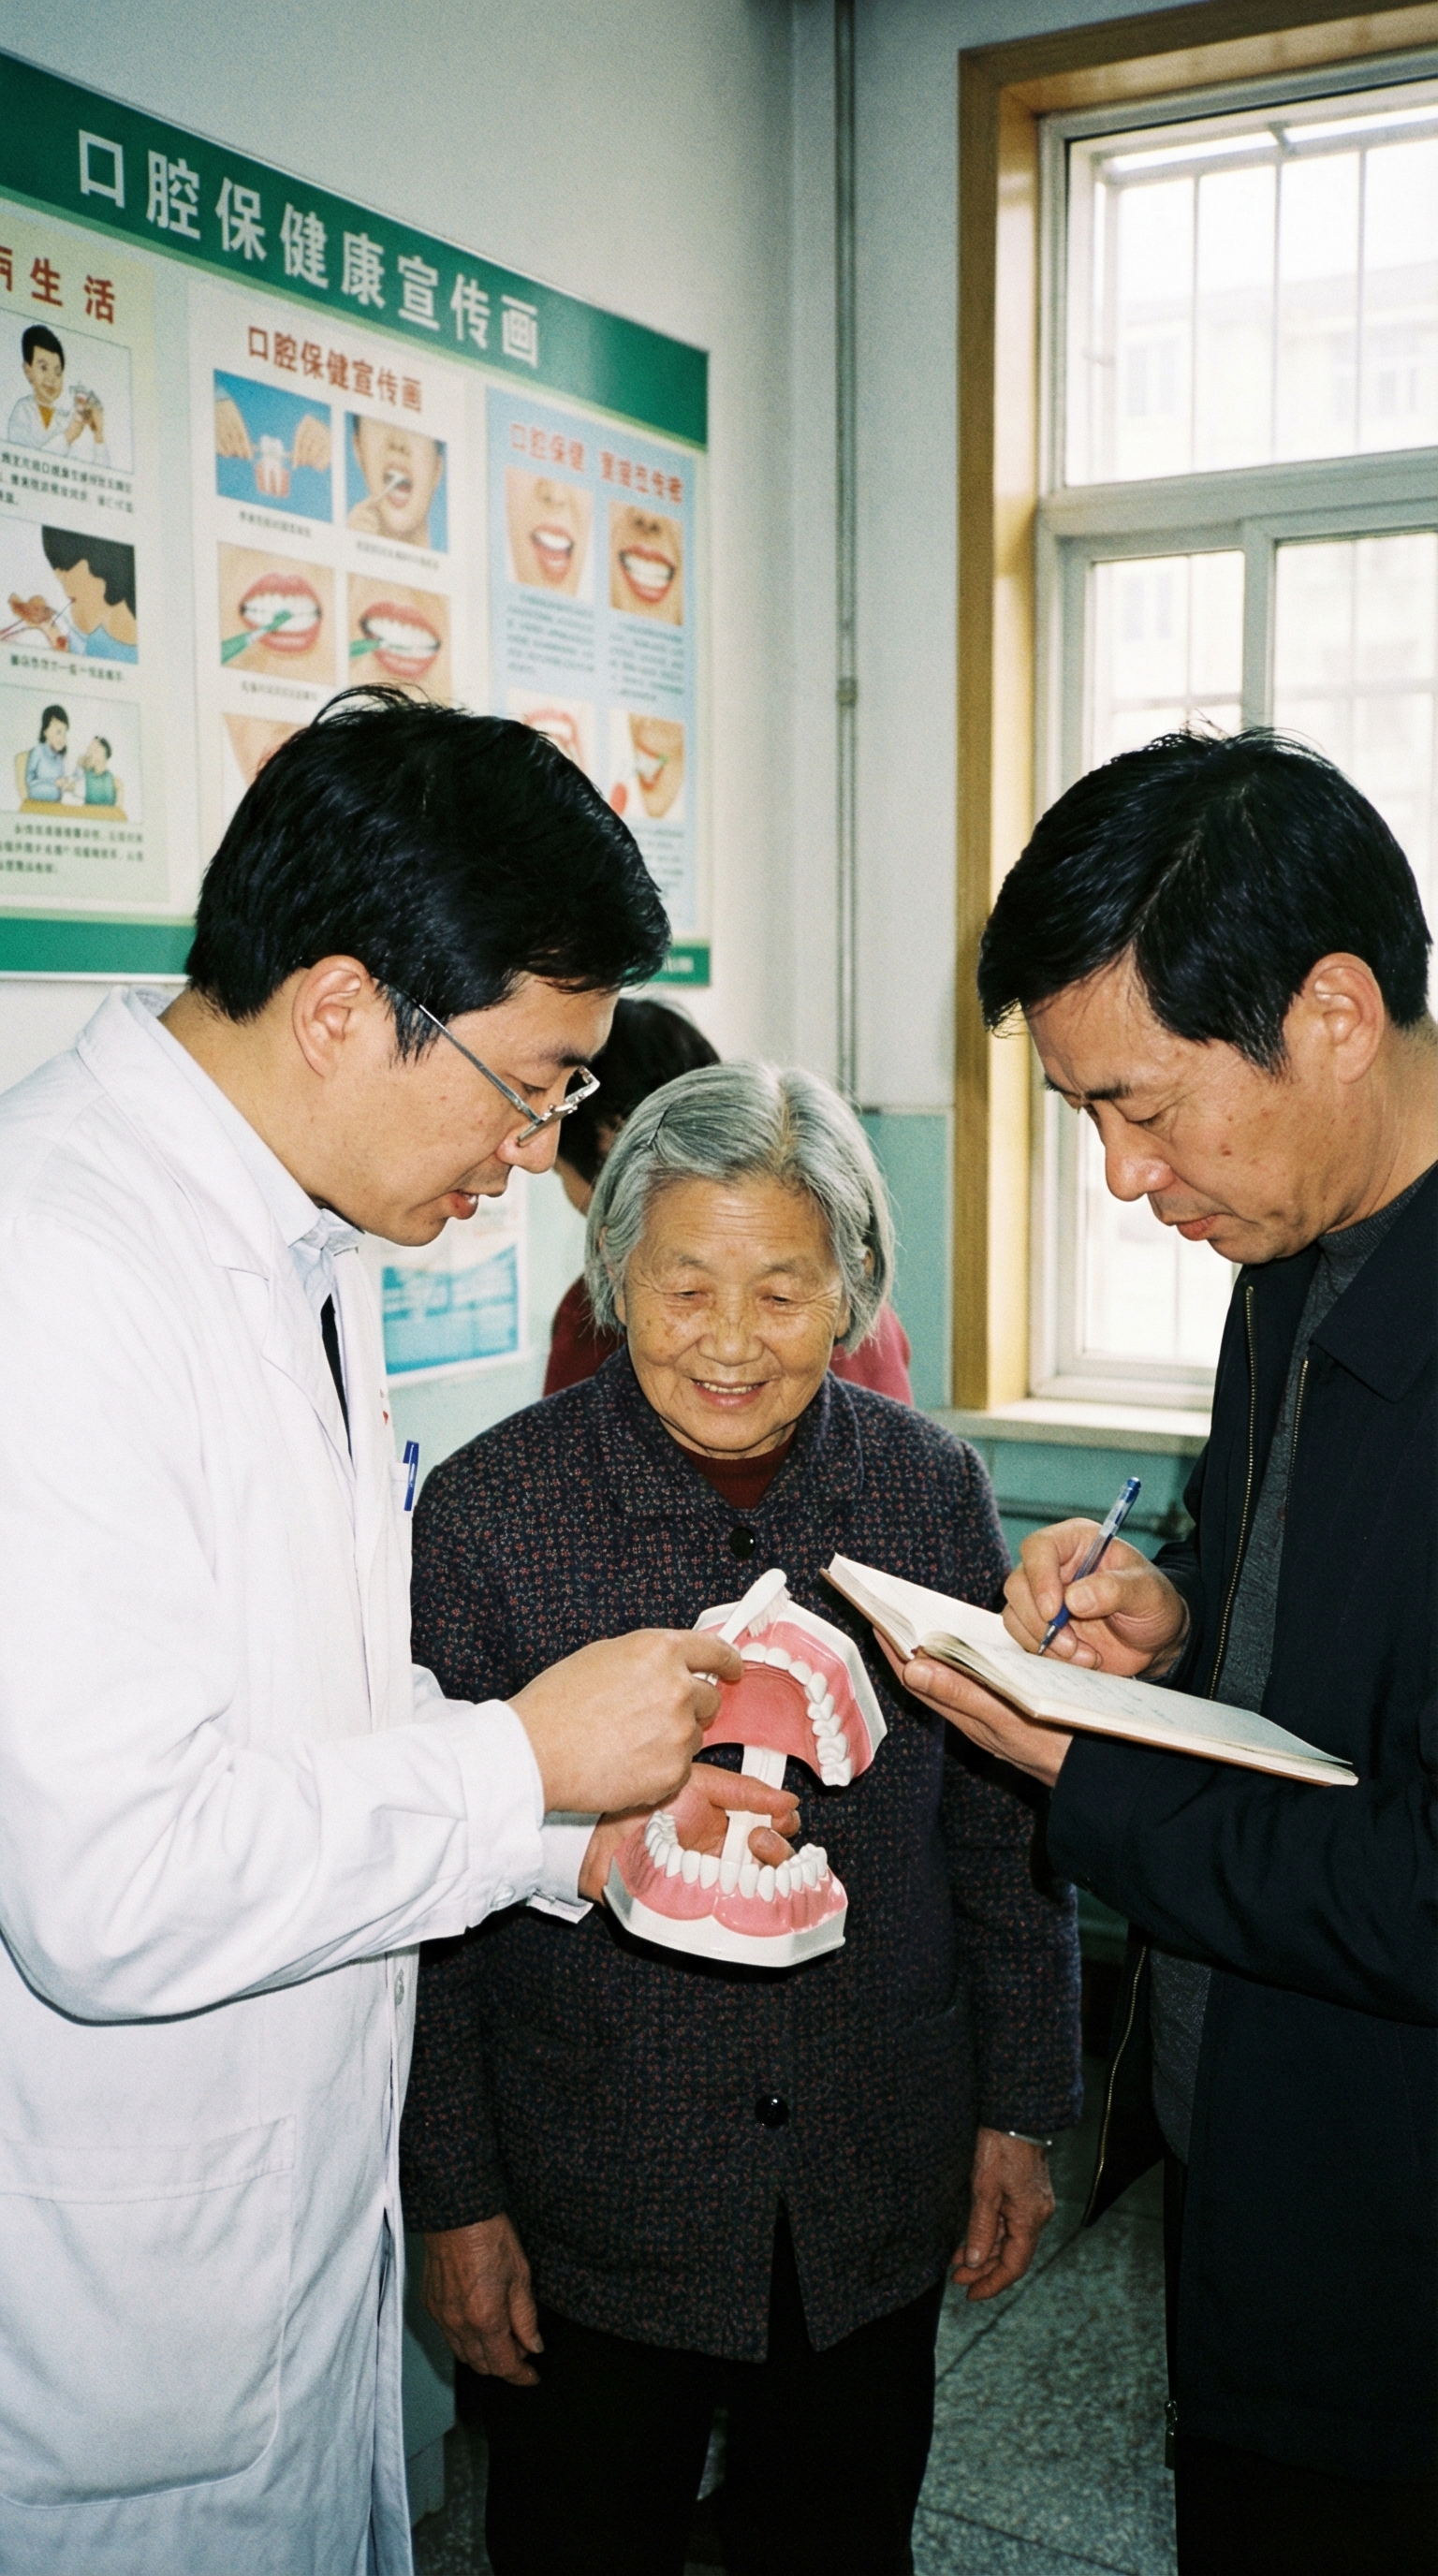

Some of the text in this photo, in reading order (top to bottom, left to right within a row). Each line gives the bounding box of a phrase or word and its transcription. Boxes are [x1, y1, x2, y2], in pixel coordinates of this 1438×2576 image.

[79, 128, 538, 369] 口腔保健康宣传画
